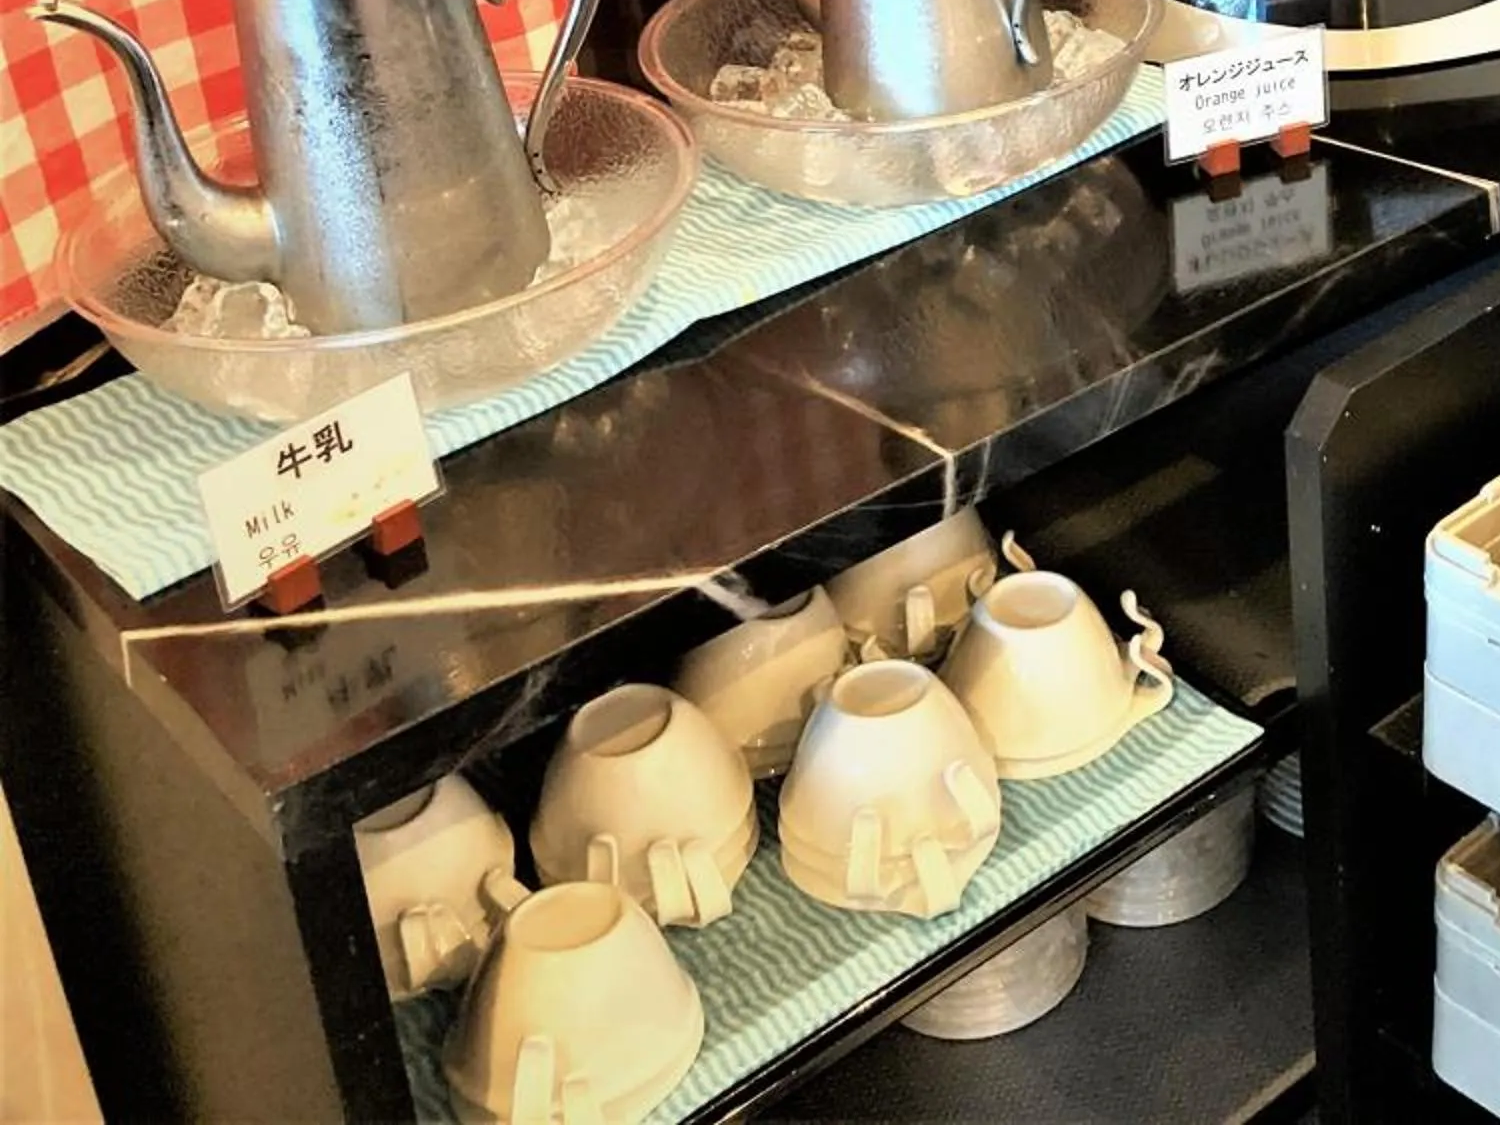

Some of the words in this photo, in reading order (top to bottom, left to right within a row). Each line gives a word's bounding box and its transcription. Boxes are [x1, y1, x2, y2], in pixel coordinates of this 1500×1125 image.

[1179, 50, 1309, 92] オレンジジュース
[1195, 86, 1246, 111] Orange
[277, 420, 353, 479] 牛乳
[244, 499, 295, 540] Milk
[258, 533, 302, 568] 우유
